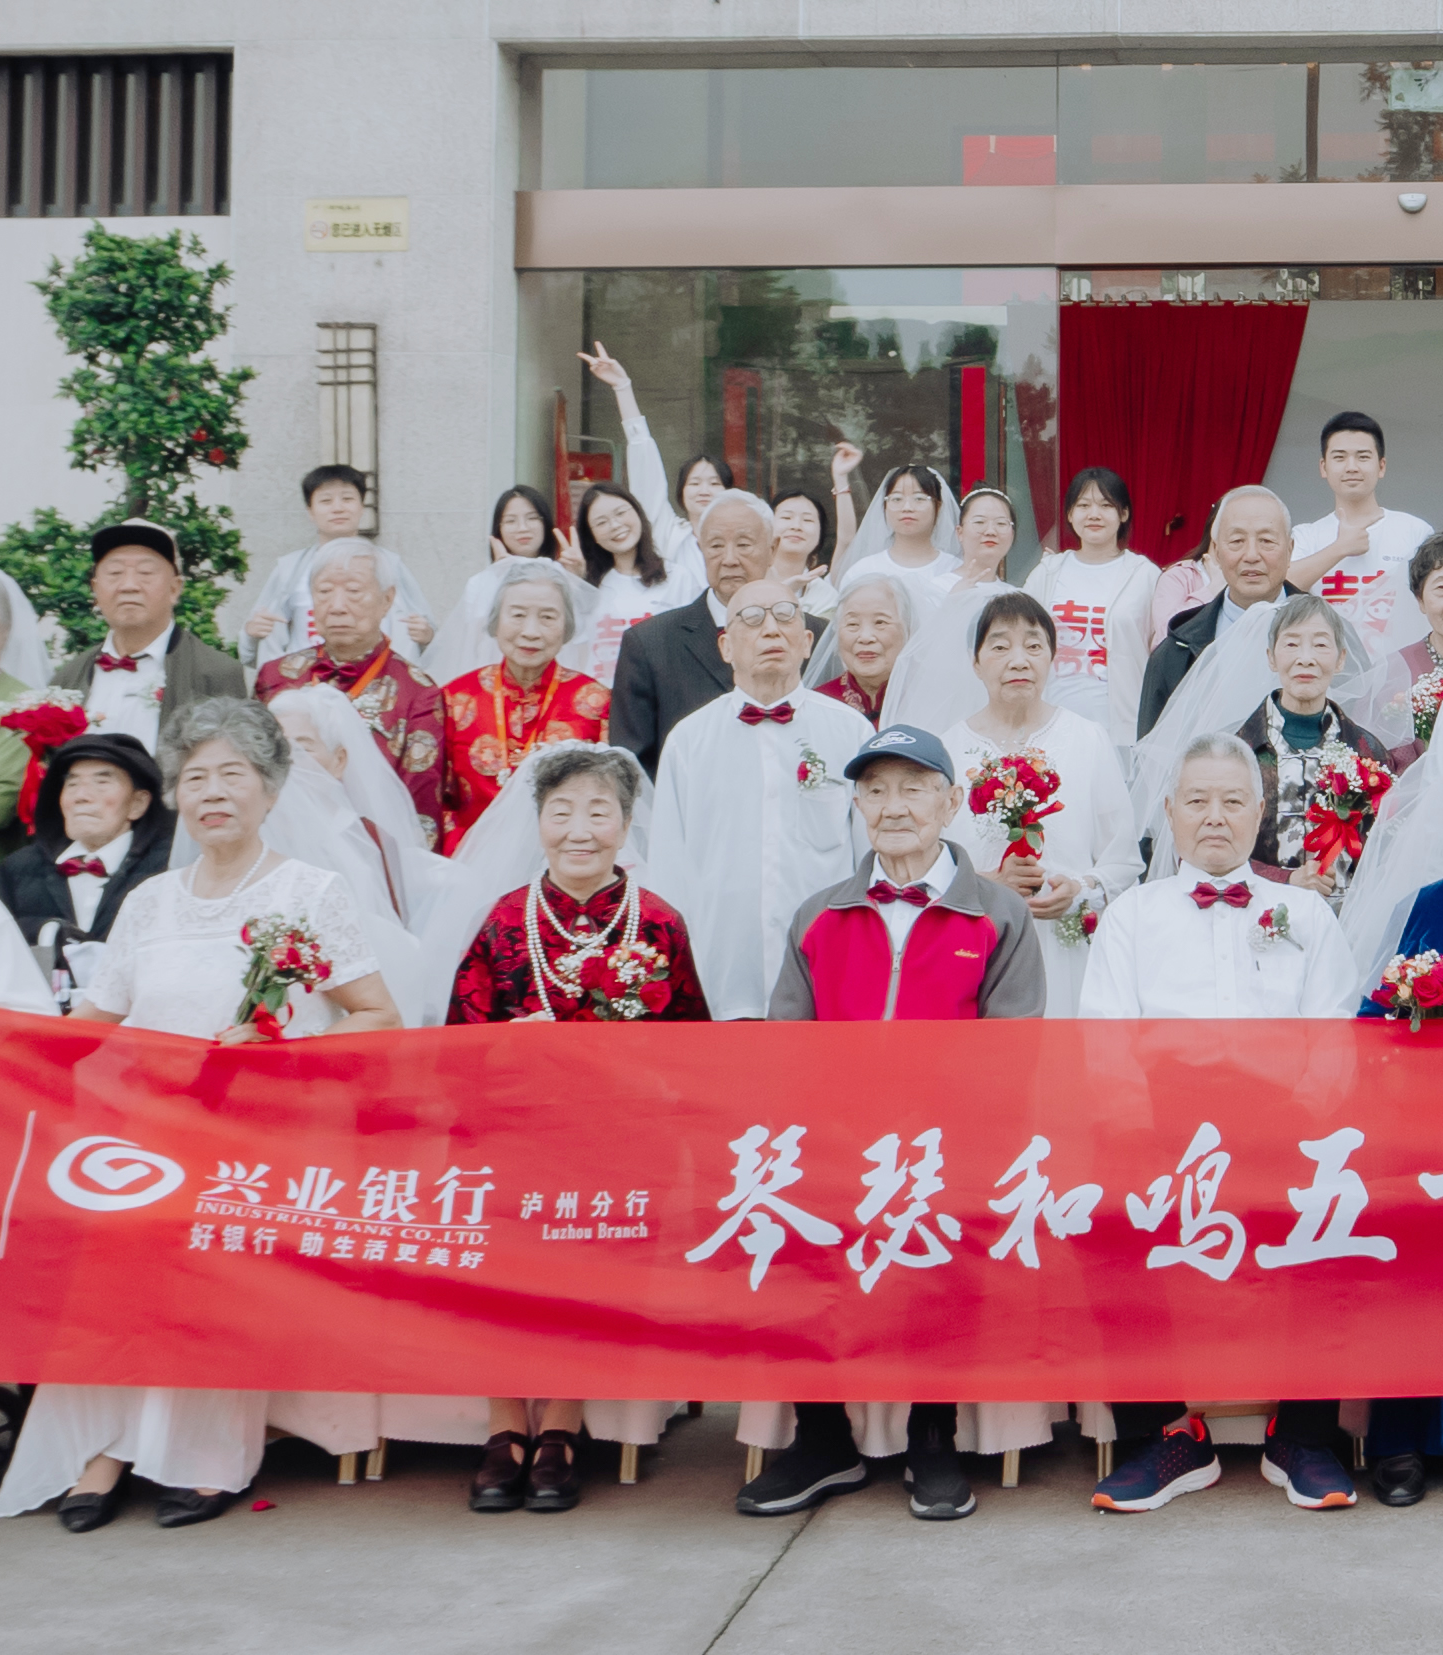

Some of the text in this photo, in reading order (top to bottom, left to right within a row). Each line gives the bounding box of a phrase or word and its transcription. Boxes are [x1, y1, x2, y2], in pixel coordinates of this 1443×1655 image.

[198, 1160, 496, 1225] 兴业银行
[519, 1189, 650, 1220] 泸州分行
[194, 1201, 328, 1229] INDUSTRIAL
[333, 1220, 395, 1237] BANK
[542, 1221, 649, 1241] Luzhou Branch
[188, 1222, 486, 1270] 好银行 助生活更美好
